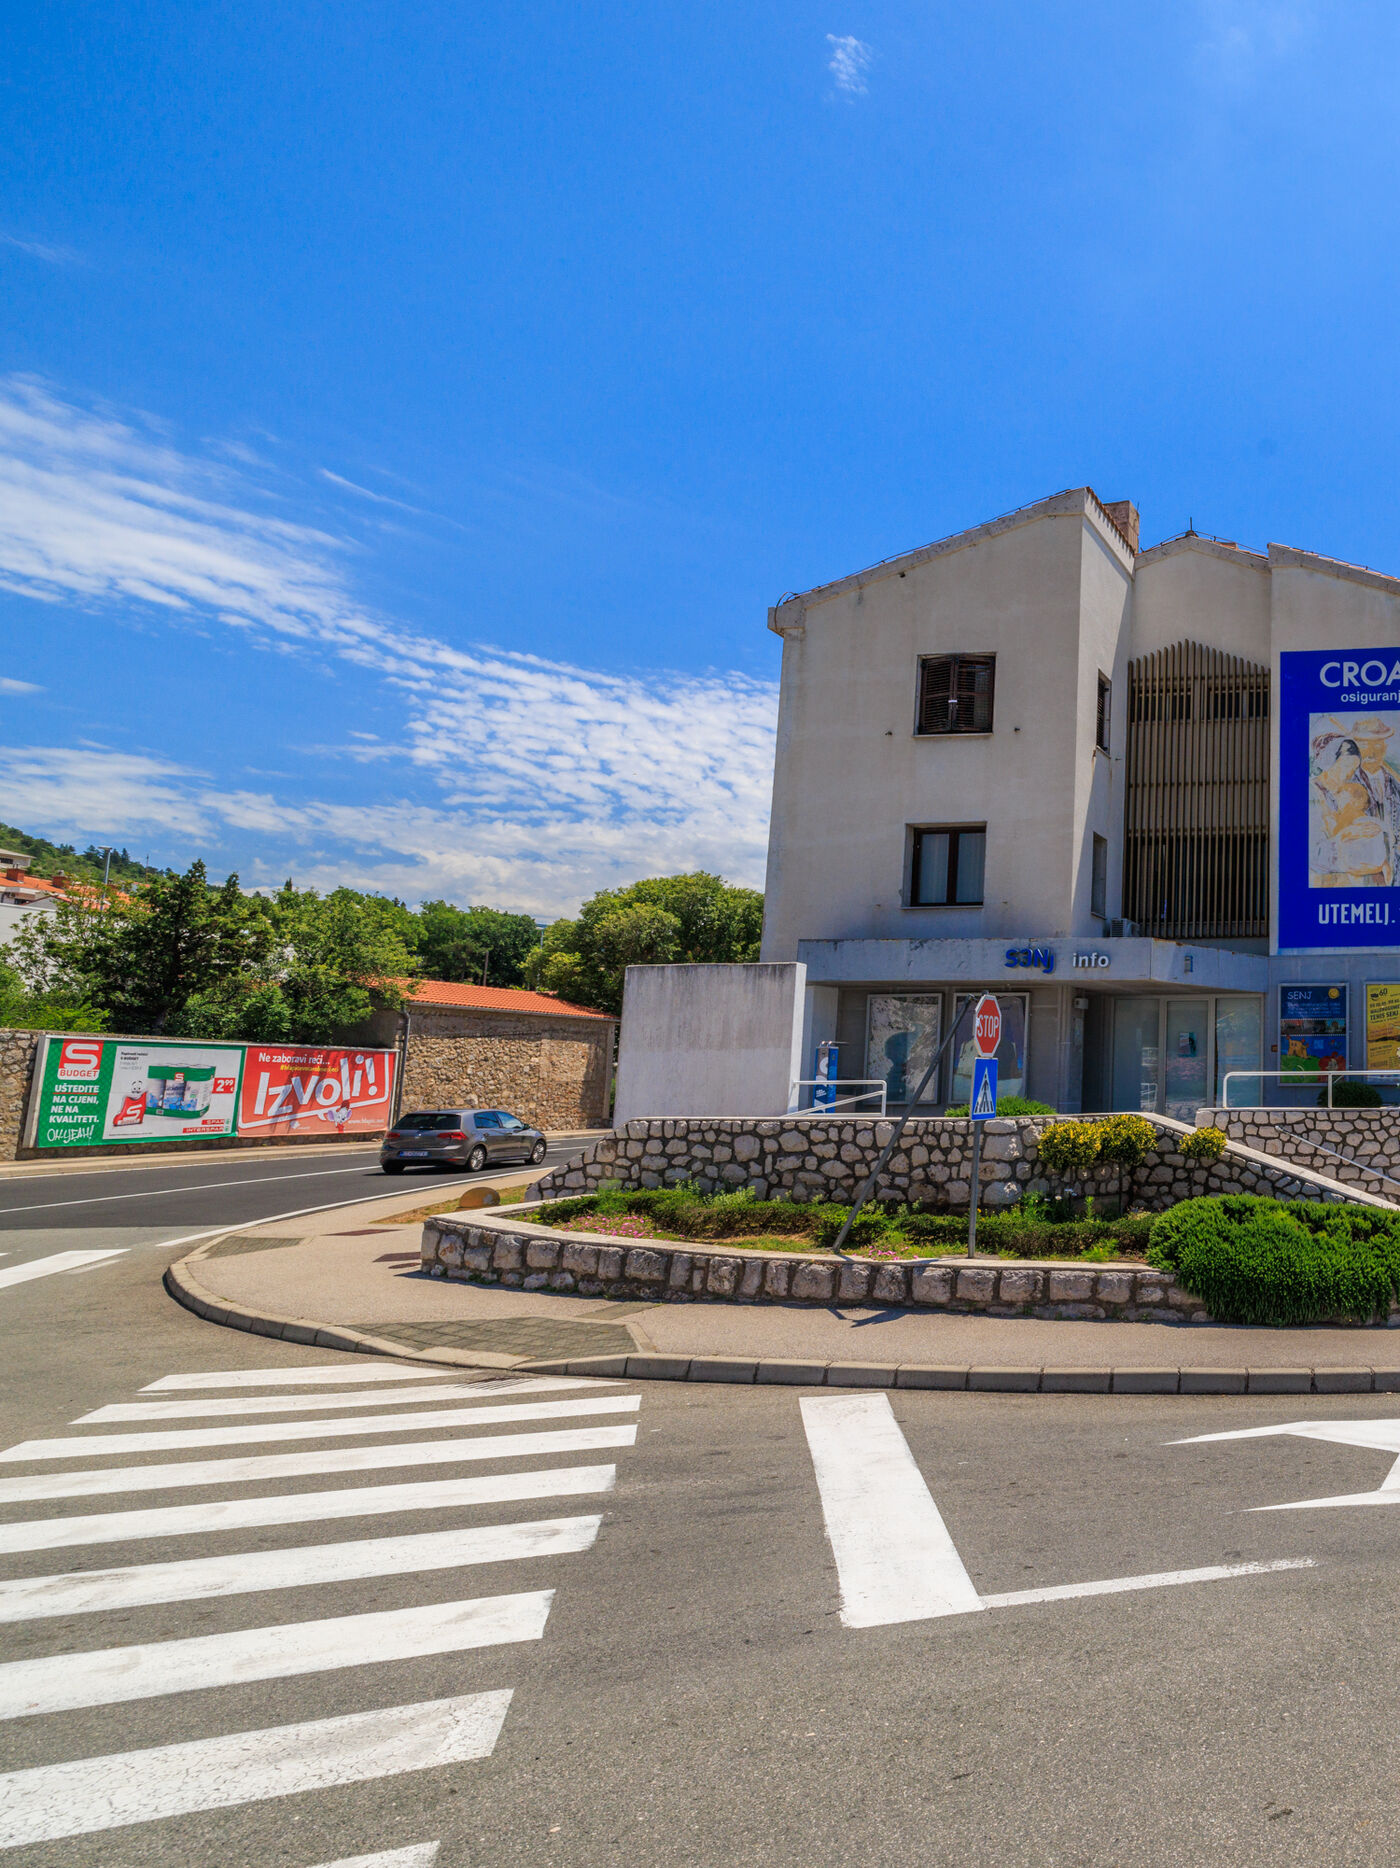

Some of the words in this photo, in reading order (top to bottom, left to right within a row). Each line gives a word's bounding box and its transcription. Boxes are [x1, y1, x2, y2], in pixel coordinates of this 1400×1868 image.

[1318, 903, 1396, 926] UTEMELJ.
[1072, 952, 1110, 969] info
[1287, 990, 1312, 1001] SENJ
[977, 1014, 1000, 1039] STOP
[258, 1052, 271, 1063] Ne
[272, 1052, 307, 1064] zaboravi
[59, 1069, 99, 1078] BUDGET
[54, 1083, 100, 1093] UŠTEDITE
[52, 1095, 67, 1104] NA
[68, 1095, 99, 1105] CIJENI,
[50, 1105, 64, 1114] NE
[65, 1105, 79, 1114] NA
[49, 1115, 100, 1124] KVALITETI.
